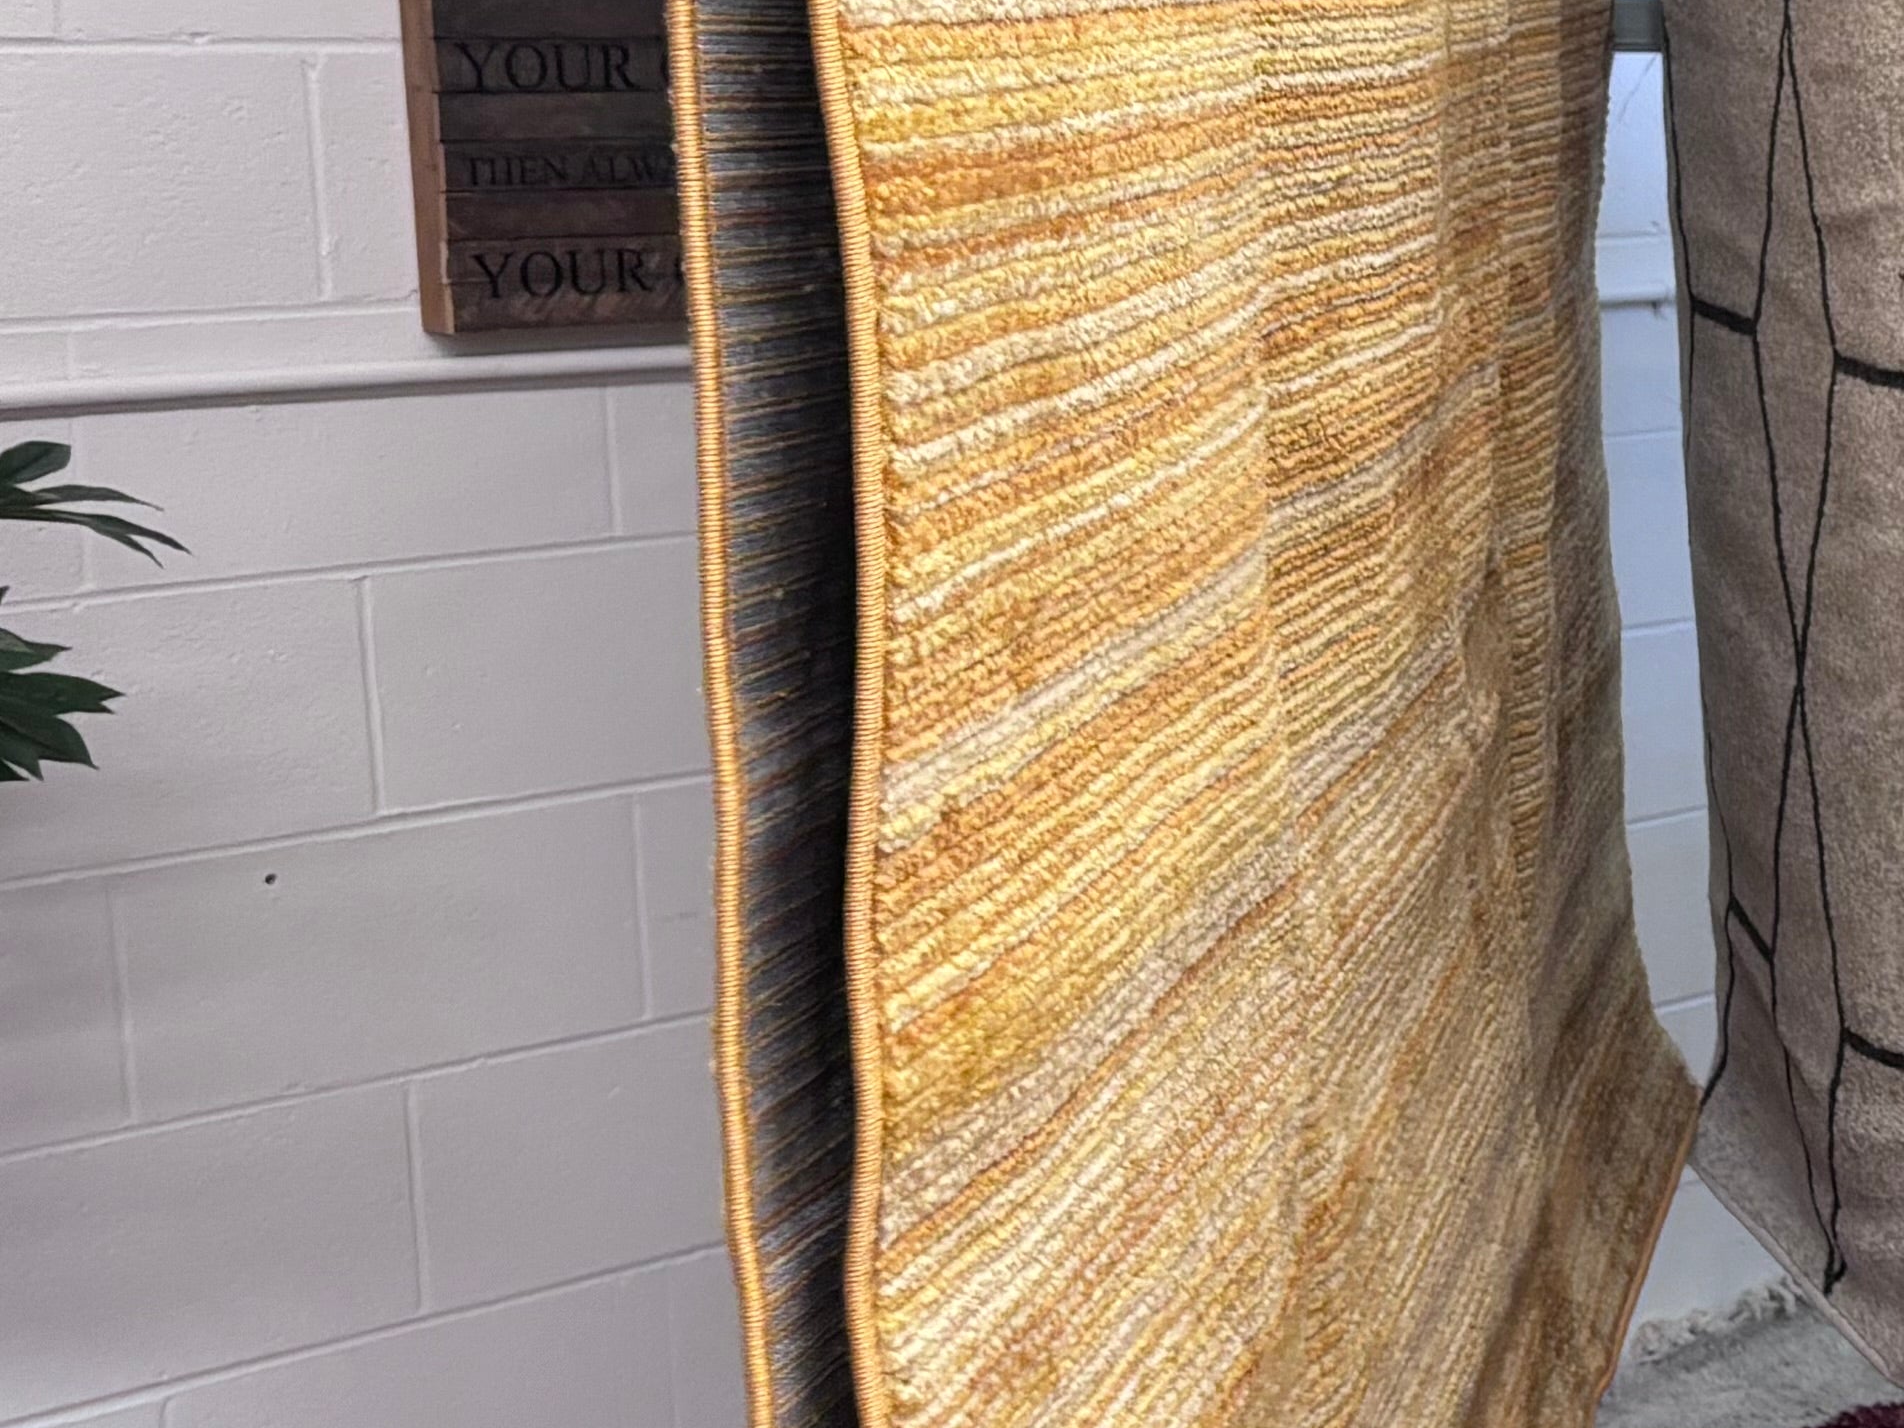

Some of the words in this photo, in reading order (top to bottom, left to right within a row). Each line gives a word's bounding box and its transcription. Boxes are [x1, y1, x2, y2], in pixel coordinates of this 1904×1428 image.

[454, 42, 636, 93] YOUR
[467, 155, 569, 186] THEN
[473, 248, 652, 300] YOUR
